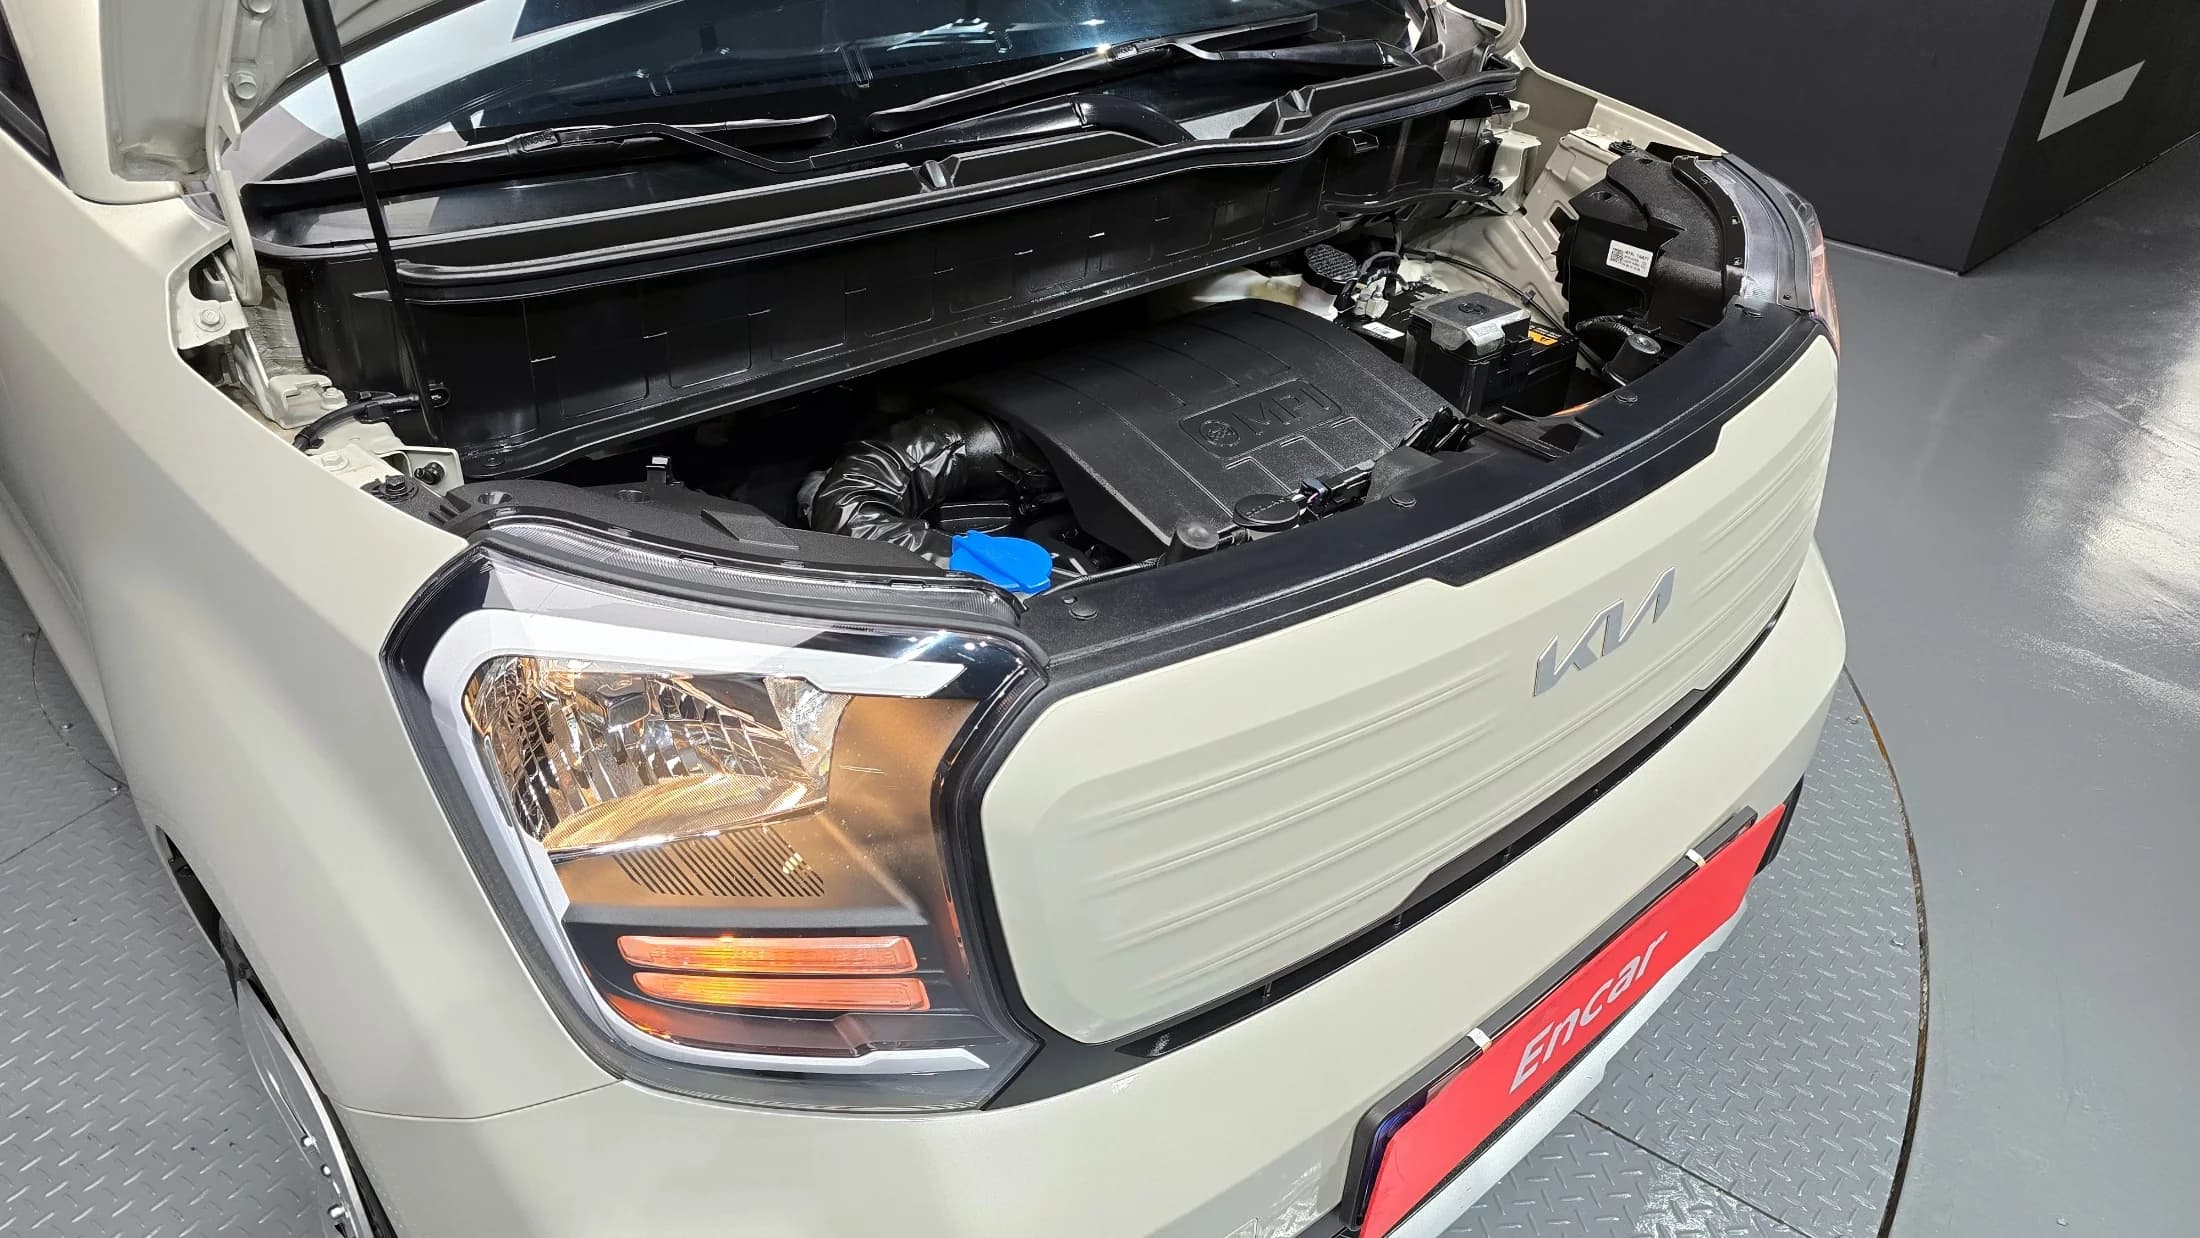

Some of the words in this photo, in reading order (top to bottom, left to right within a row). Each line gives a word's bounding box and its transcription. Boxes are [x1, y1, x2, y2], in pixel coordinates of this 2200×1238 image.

[1230, 387, 1332, 436] MPI
[1532, 566, 1676, 697] KIA
[1508, 930, 1668, 1095] Encar
